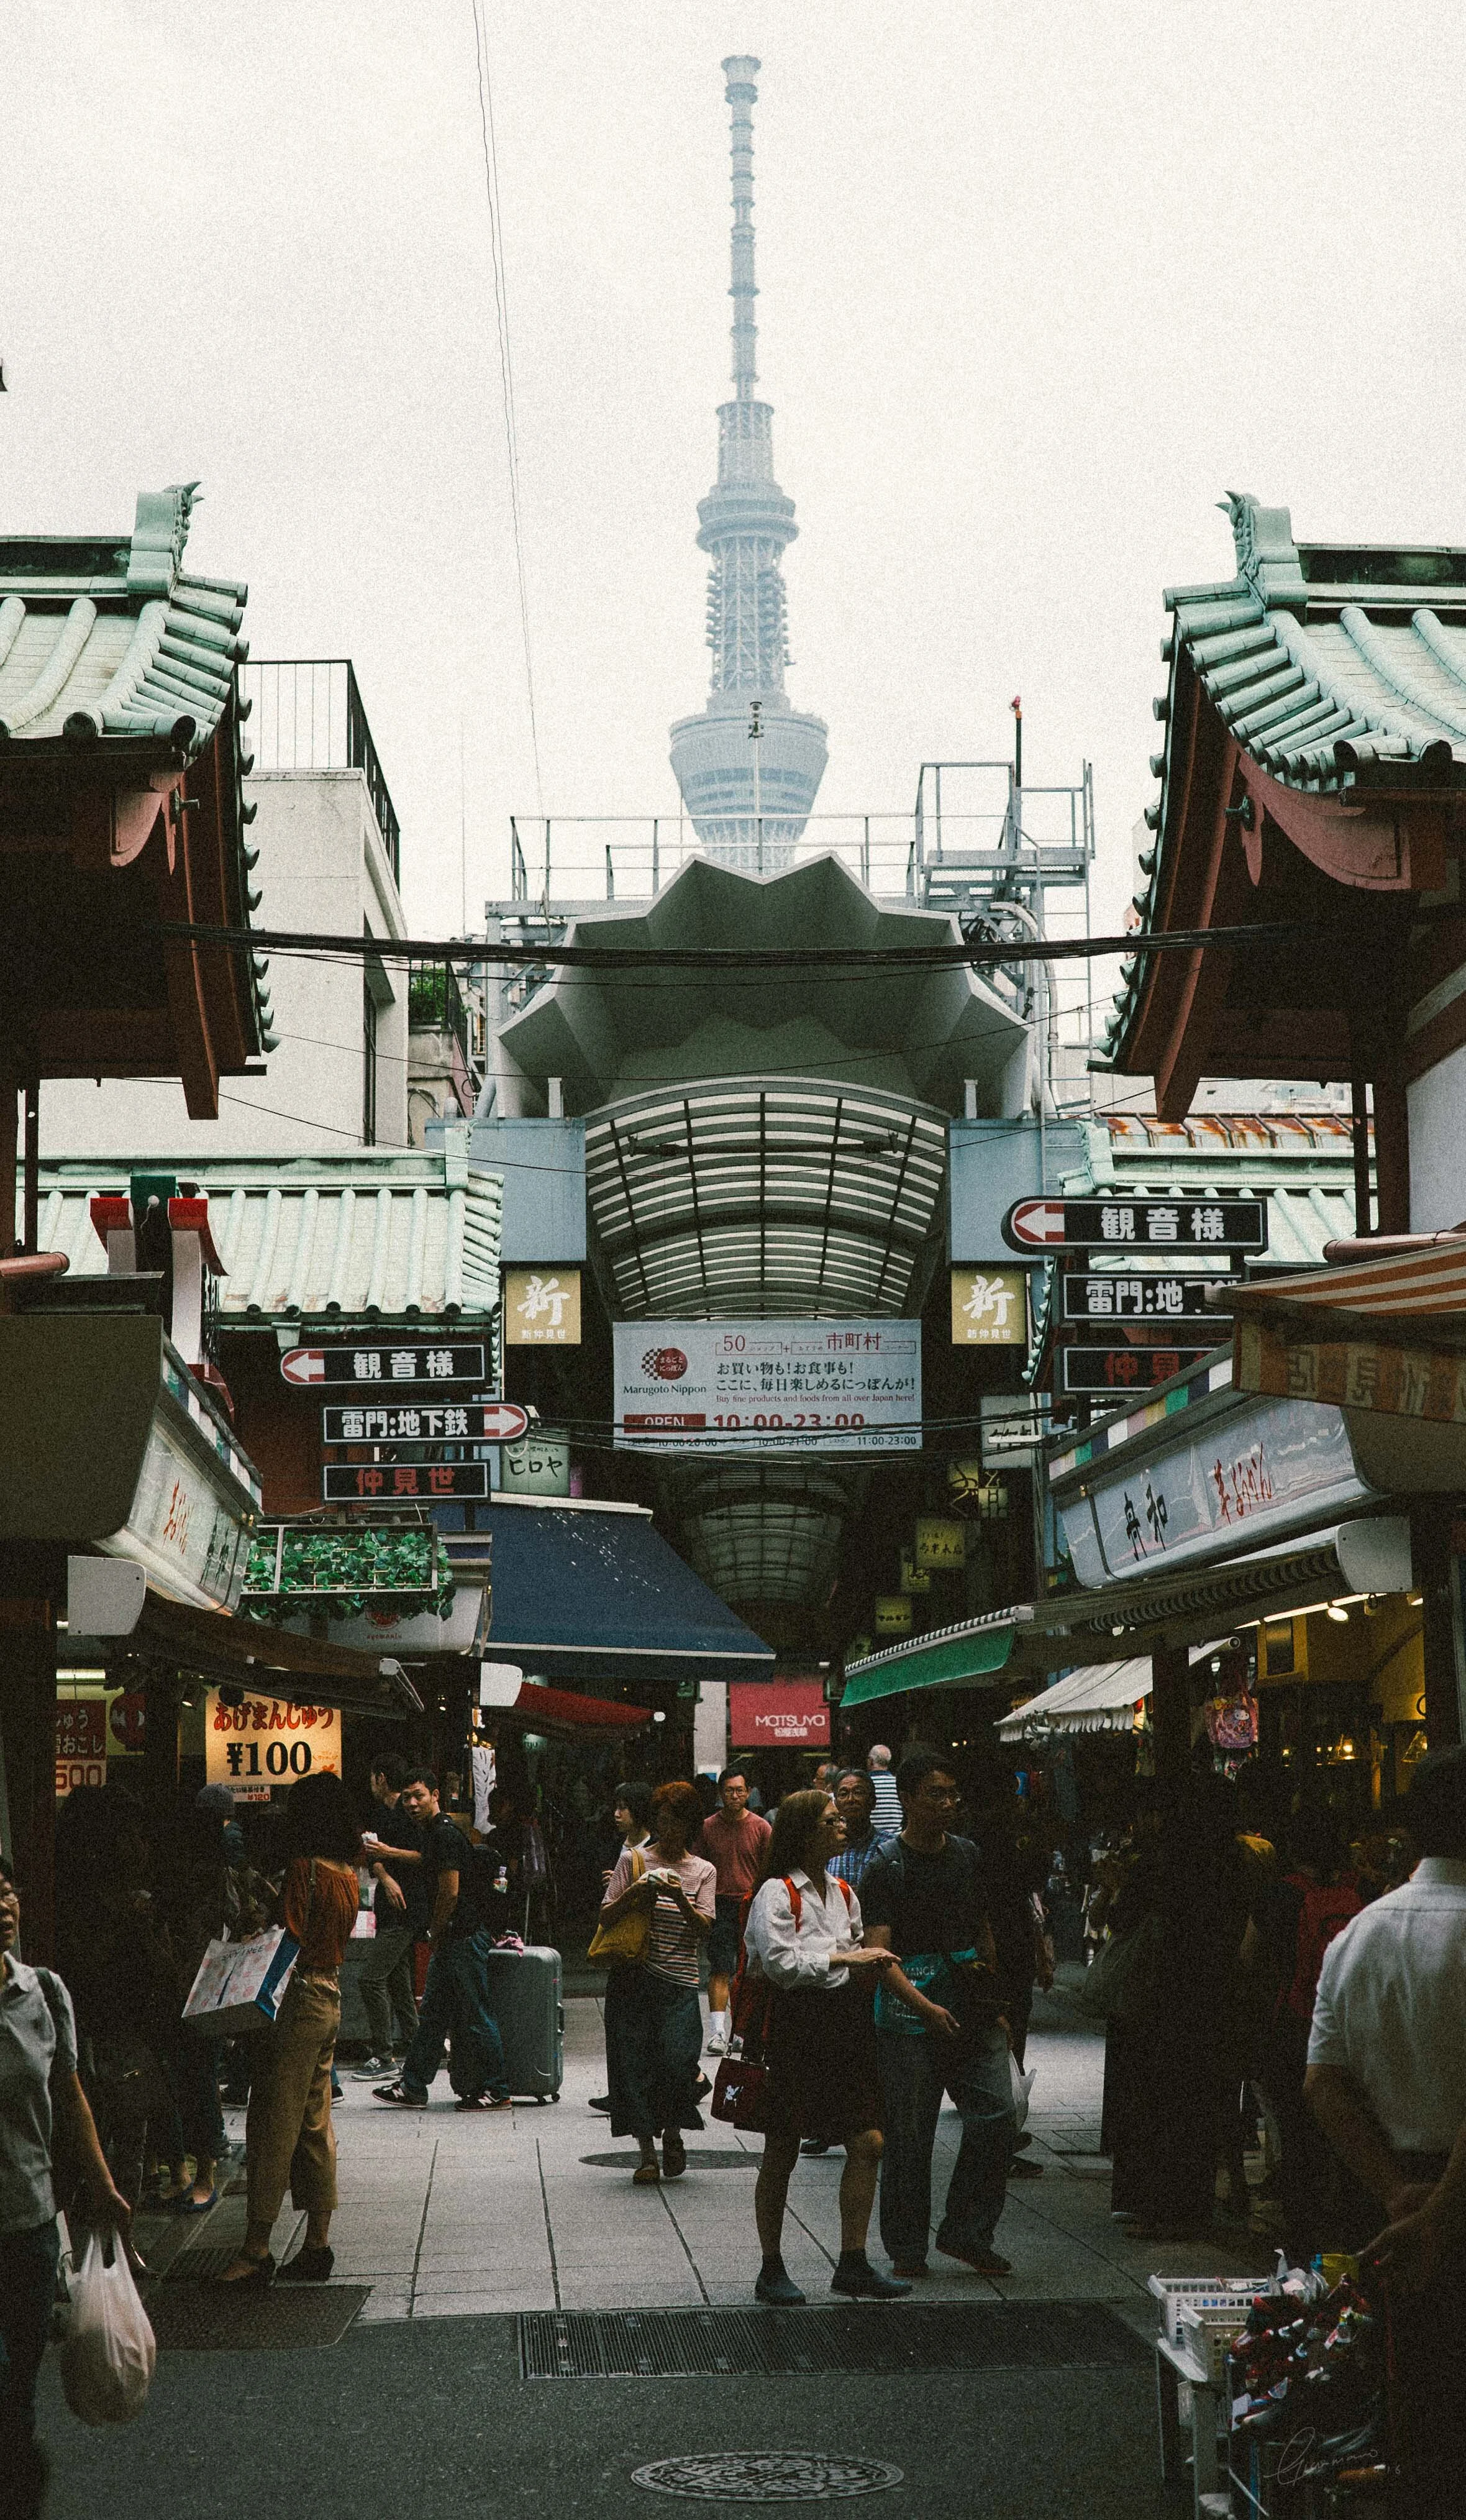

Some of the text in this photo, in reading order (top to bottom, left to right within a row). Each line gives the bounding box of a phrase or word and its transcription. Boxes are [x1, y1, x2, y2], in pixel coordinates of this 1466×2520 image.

[1101, 1207, 1225, 1241] 観音様
[517, 1276, 571, 1325] 新
[962, 1275, 1015, 1325] 新
[1086, 1280, 1239, 1313] 雷門:地
[521, 1329, 566, 1339] 新仲見世
[724, 1335, 746, 1351] 50
[826, 1333, 881, 1351] 市町村
[967, 1329, 1011, 1339] 新仲見世
[353, 1350, 454, 1379] 観音様
[717, 1362, 854, 1375] お買い物も!お食事も!
[1104, 1351, 1218, 1386] 仲見
[623, 1386, 706, 1397] Marugoto Nippon
[716, 1377, 915, 1391] ここに、毎日楽しめるにっぽんが!
[716, 1395, 730, 1404] Buy
[749, 1395, 781, 1404] products
[872, 1394, 893, 1404] Japan
[644, 1413, 865, 1431] OPEN 10:00-23:00
[858, 1436, 917, 1445] 11:00-23:00
[509, 1456, 563, 1478] ヒロヤ
[356, 1467, 456, 1495] 仲見世
[213, 1700, 335, 1732] あげまんじゅう
[225, 1740, 312, 1776] ¥100
[247, 1793, 270, 1801] ¥120
